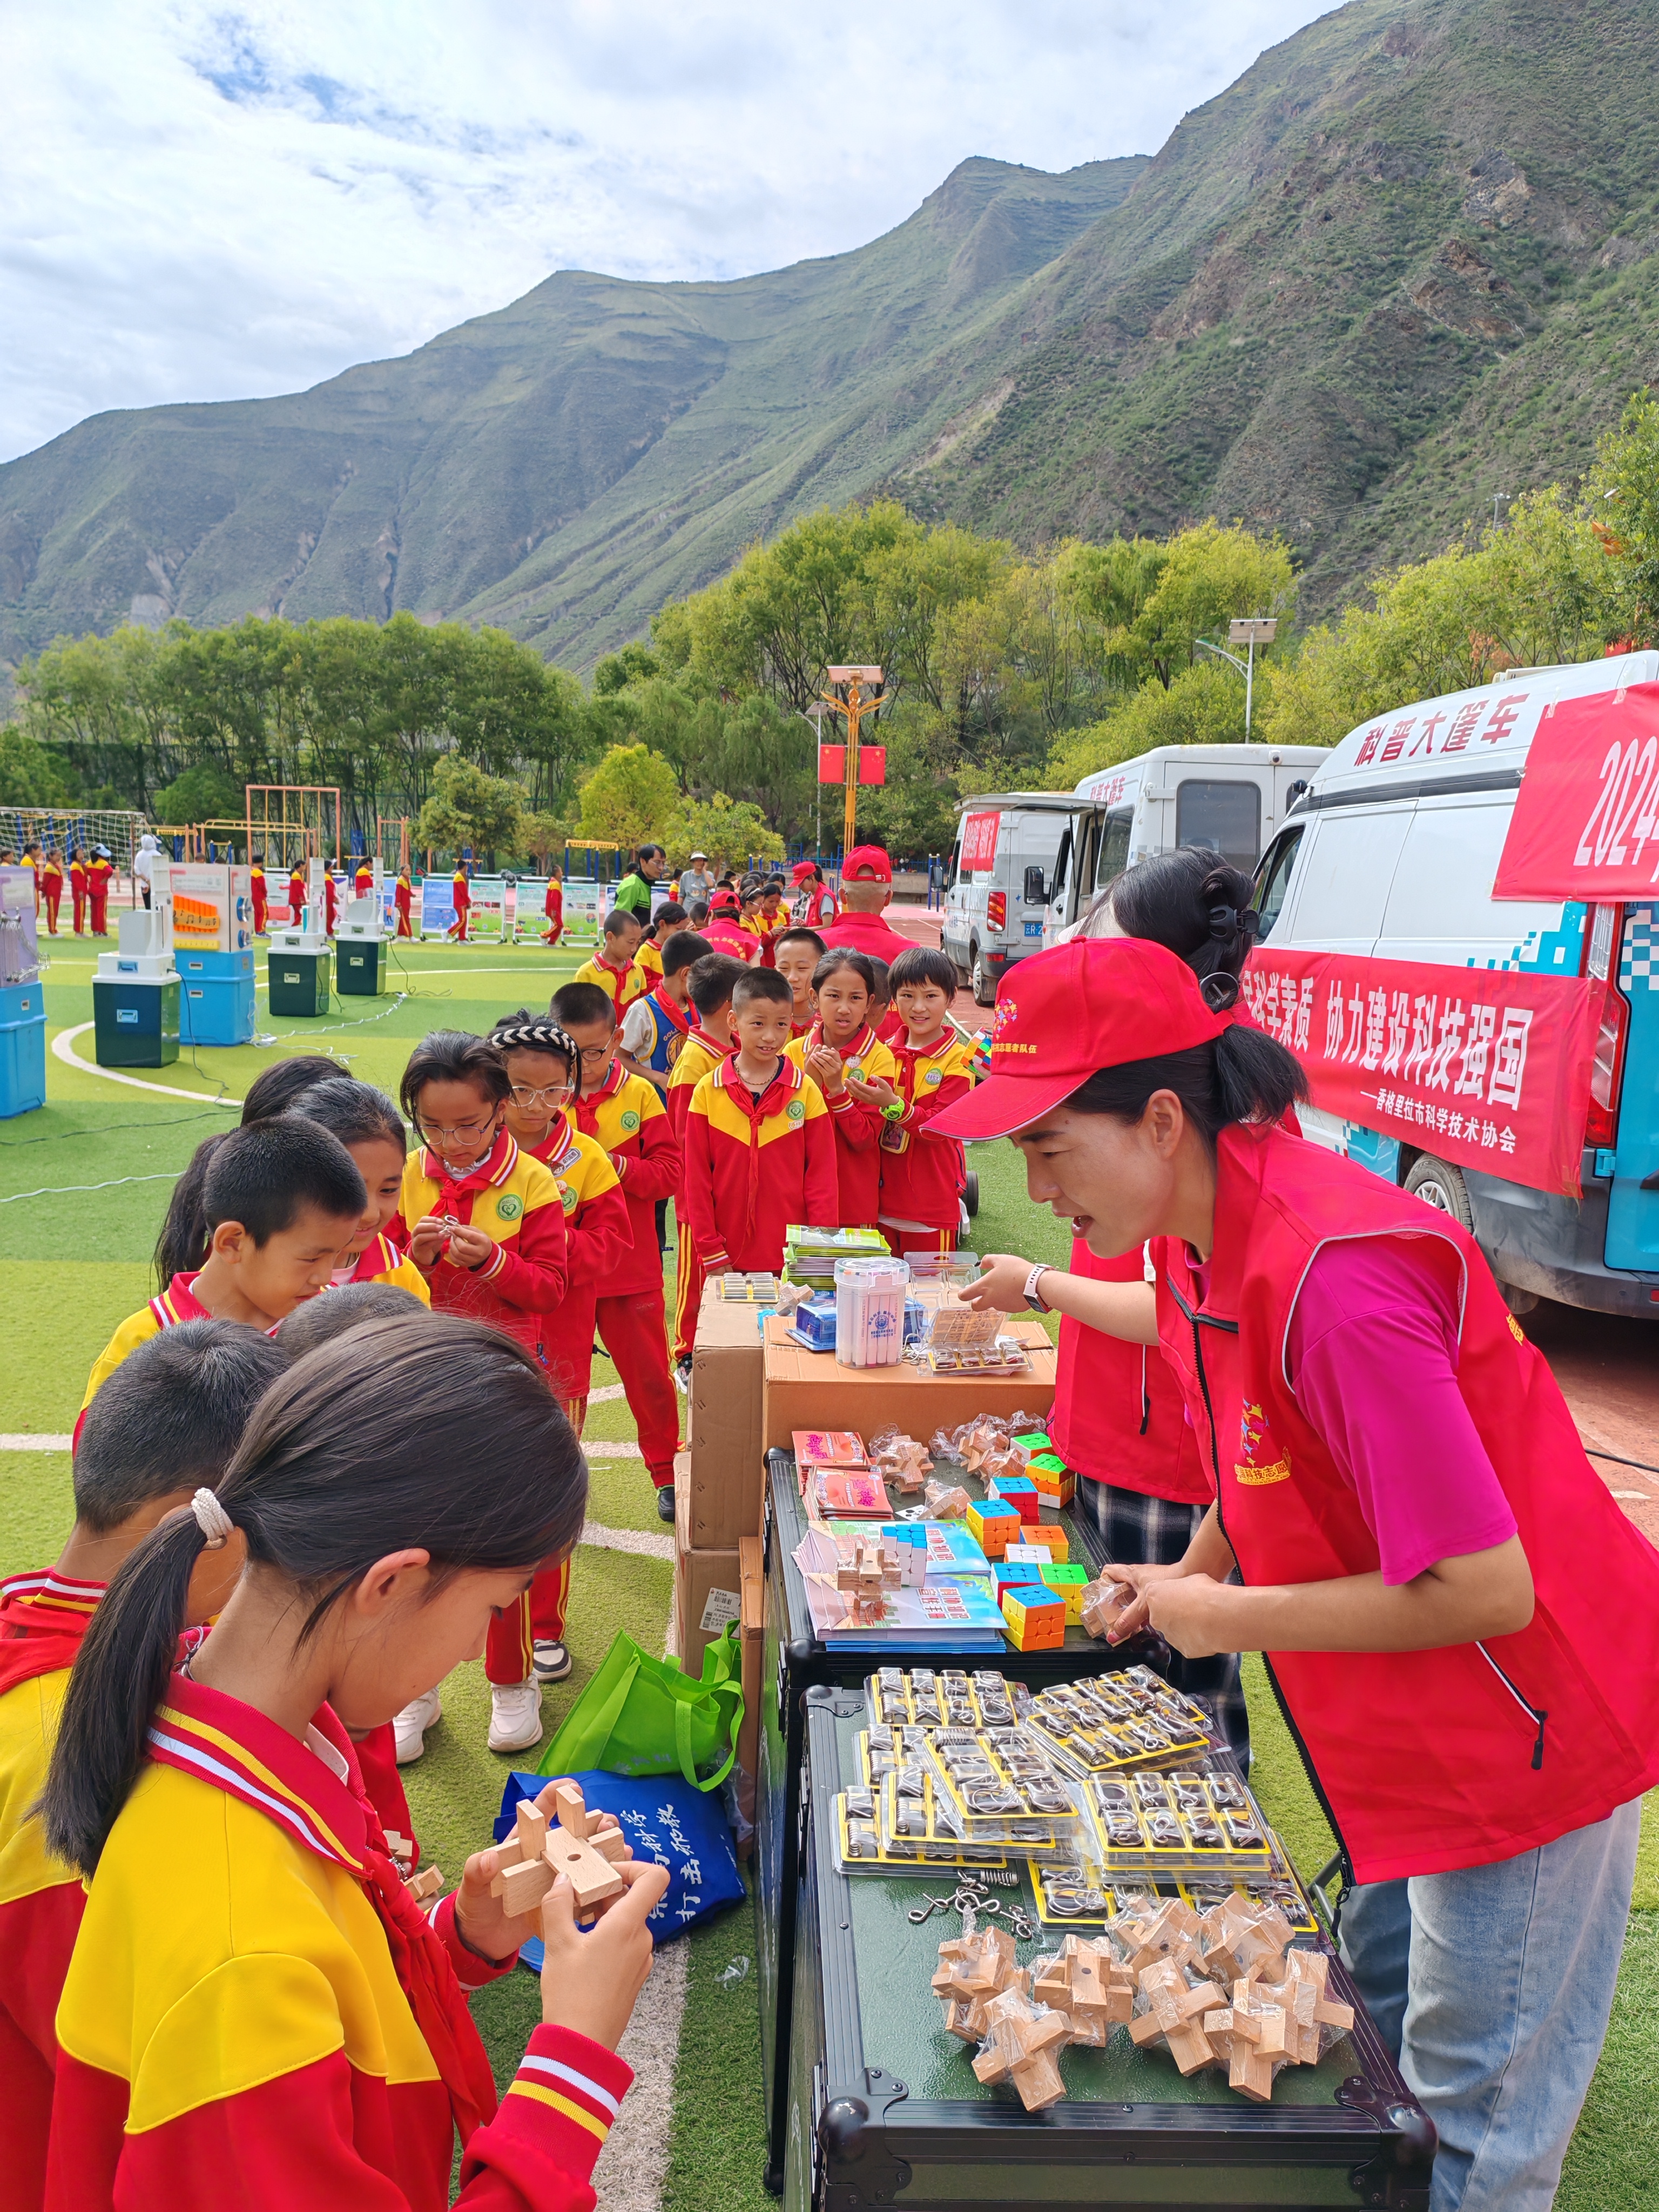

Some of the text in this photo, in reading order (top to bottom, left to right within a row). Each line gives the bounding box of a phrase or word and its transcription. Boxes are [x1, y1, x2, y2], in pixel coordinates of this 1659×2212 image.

[1353, 693, 1530, 766] 科普大篷车
[1323, 980, 1534, 1111] 协力建设科技强国
[918, 1588, 948, 1619] 宣传手册
[939, 1588, 970, 1619] 科协知识
[656, 1803, 703, 1923] 打击邪教
